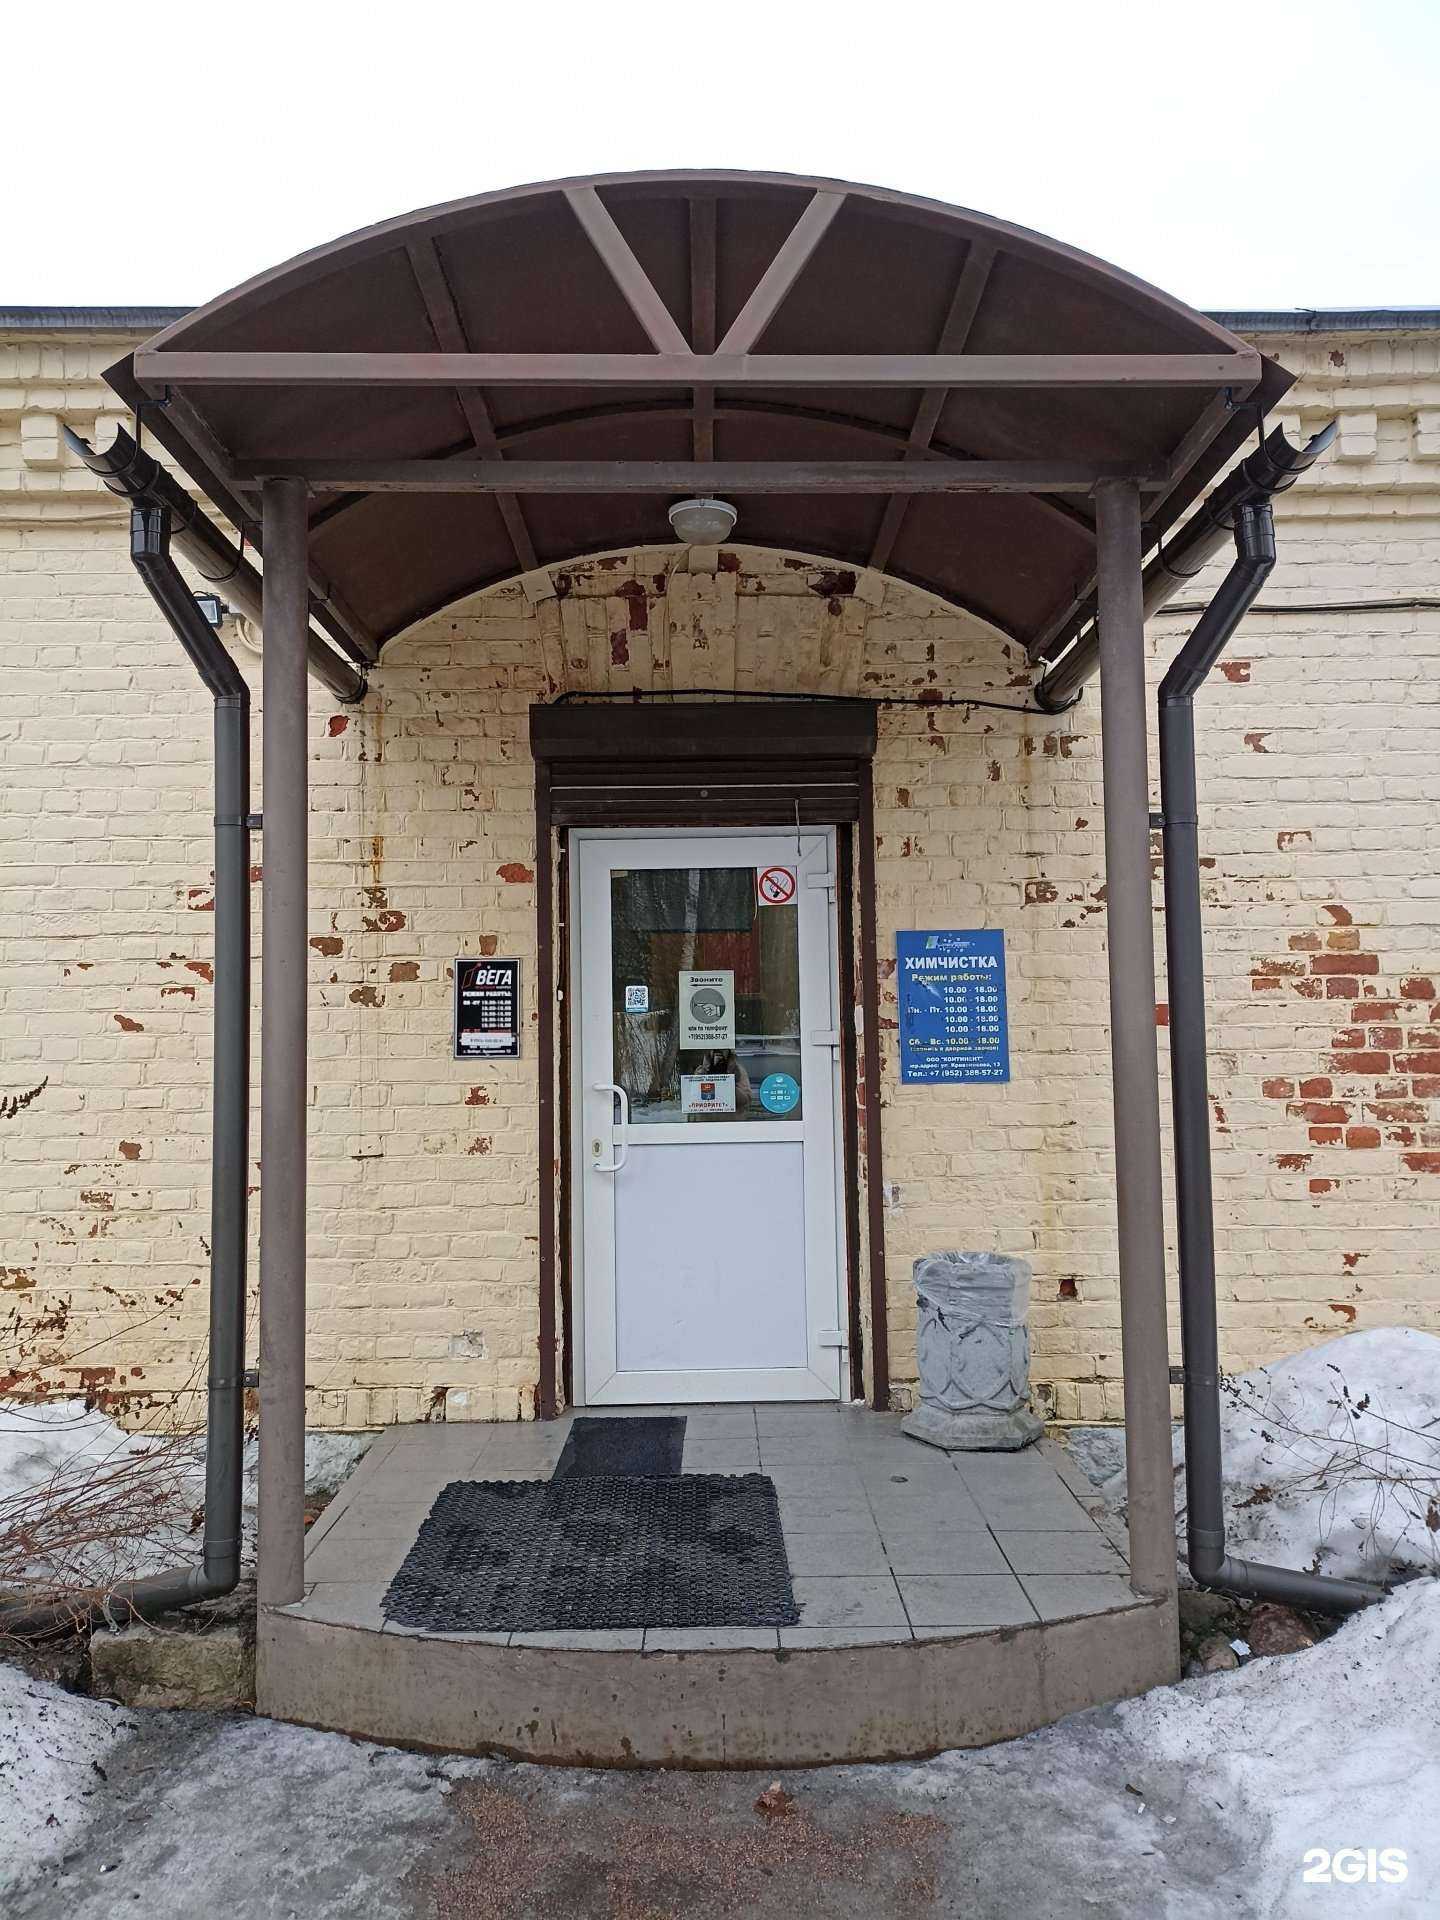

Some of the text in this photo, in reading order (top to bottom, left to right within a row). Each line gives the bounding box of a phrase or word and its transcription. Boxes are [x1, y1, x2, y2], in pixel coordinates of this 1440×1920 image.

[904, 956, 998, 970] ХИМЧИСТКА
[475, 969, 512, 985] ВЕГА
[911, 973, 992, 983] Режим работы:
[943, 986, 967, 994] 10.00
[943, 996, 967, 1004] 10.00
[964, 1069, 1004, 1077] 388-57-27
